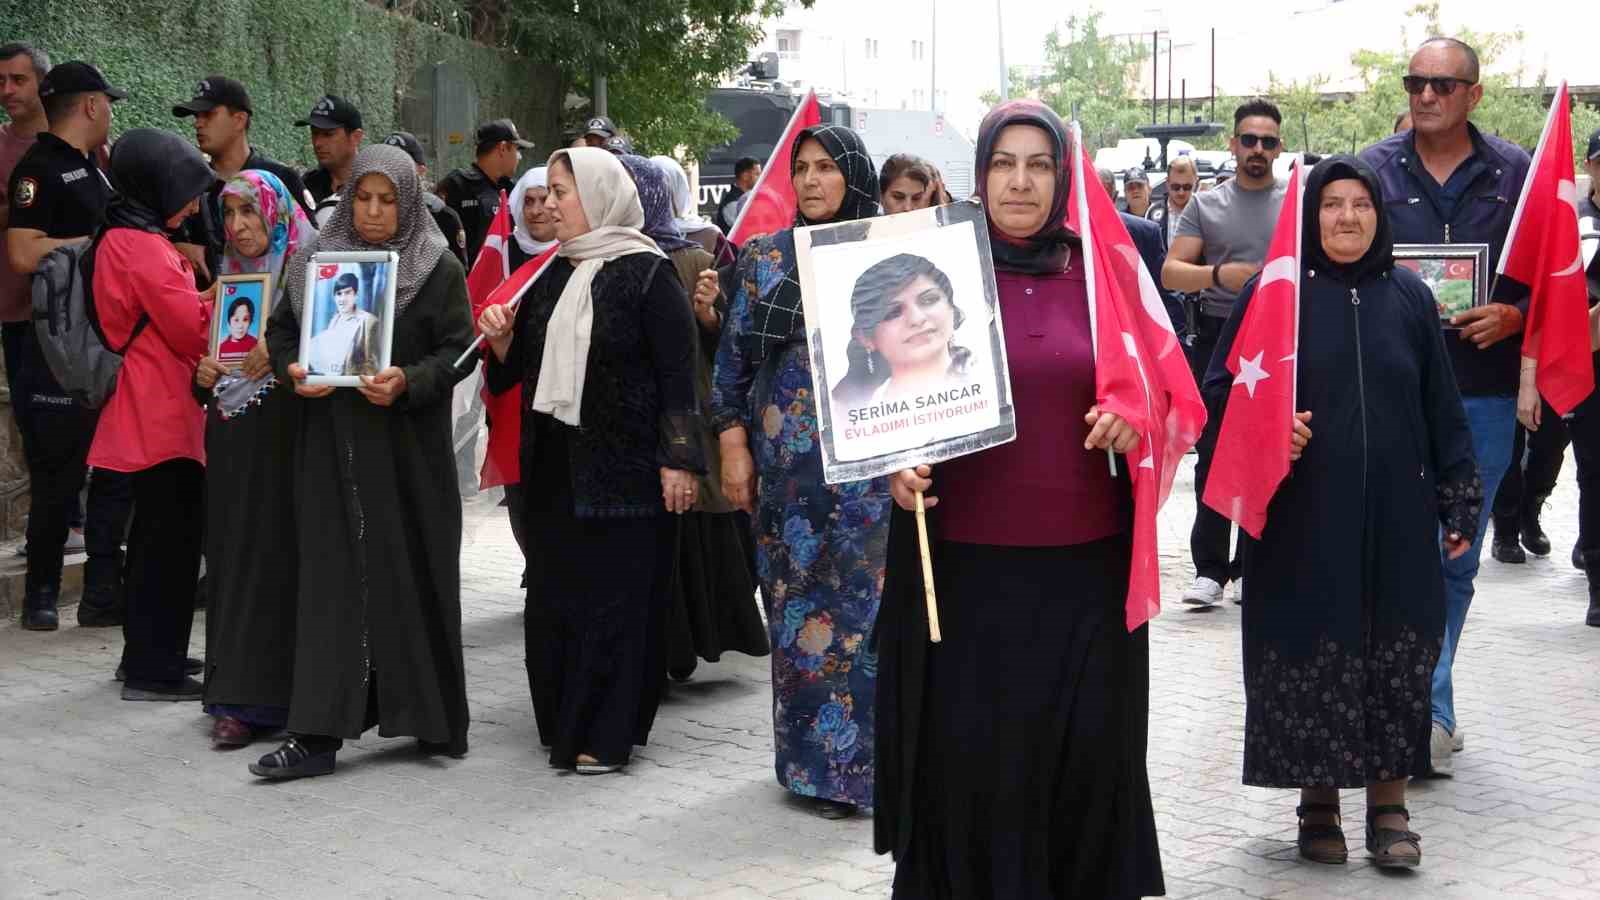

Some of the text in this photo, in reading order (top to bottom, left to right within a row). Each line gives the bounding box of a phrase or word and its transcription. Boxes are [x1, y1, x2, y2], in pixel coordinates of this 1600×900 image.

[848, 383, 981, 425] ŞERİMA SANCAR
[845, 417, 909, 440] EVLADIMI
